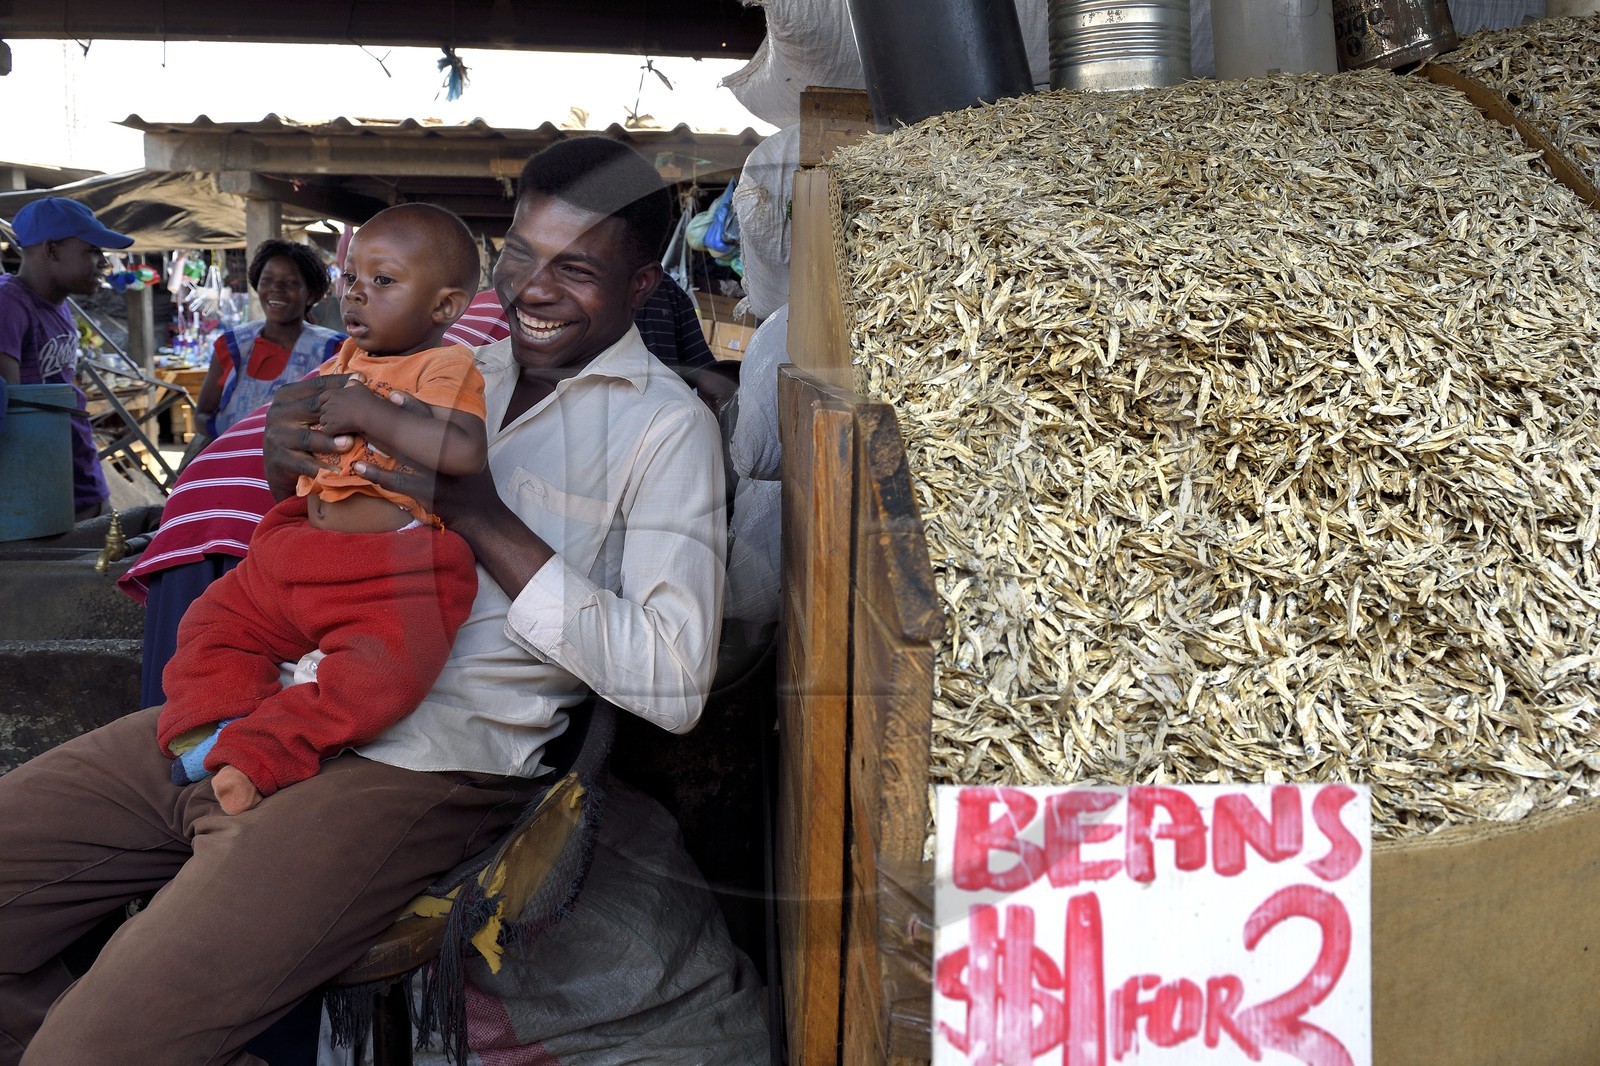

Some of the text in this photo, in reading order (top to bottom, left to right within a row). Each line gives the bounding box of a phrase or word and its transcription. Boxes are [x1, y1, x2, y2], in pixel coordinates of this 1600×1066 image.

[953, 785, 1362, 892] BEANS
[935, 884, 1353, 1066] $1 FOR 2
